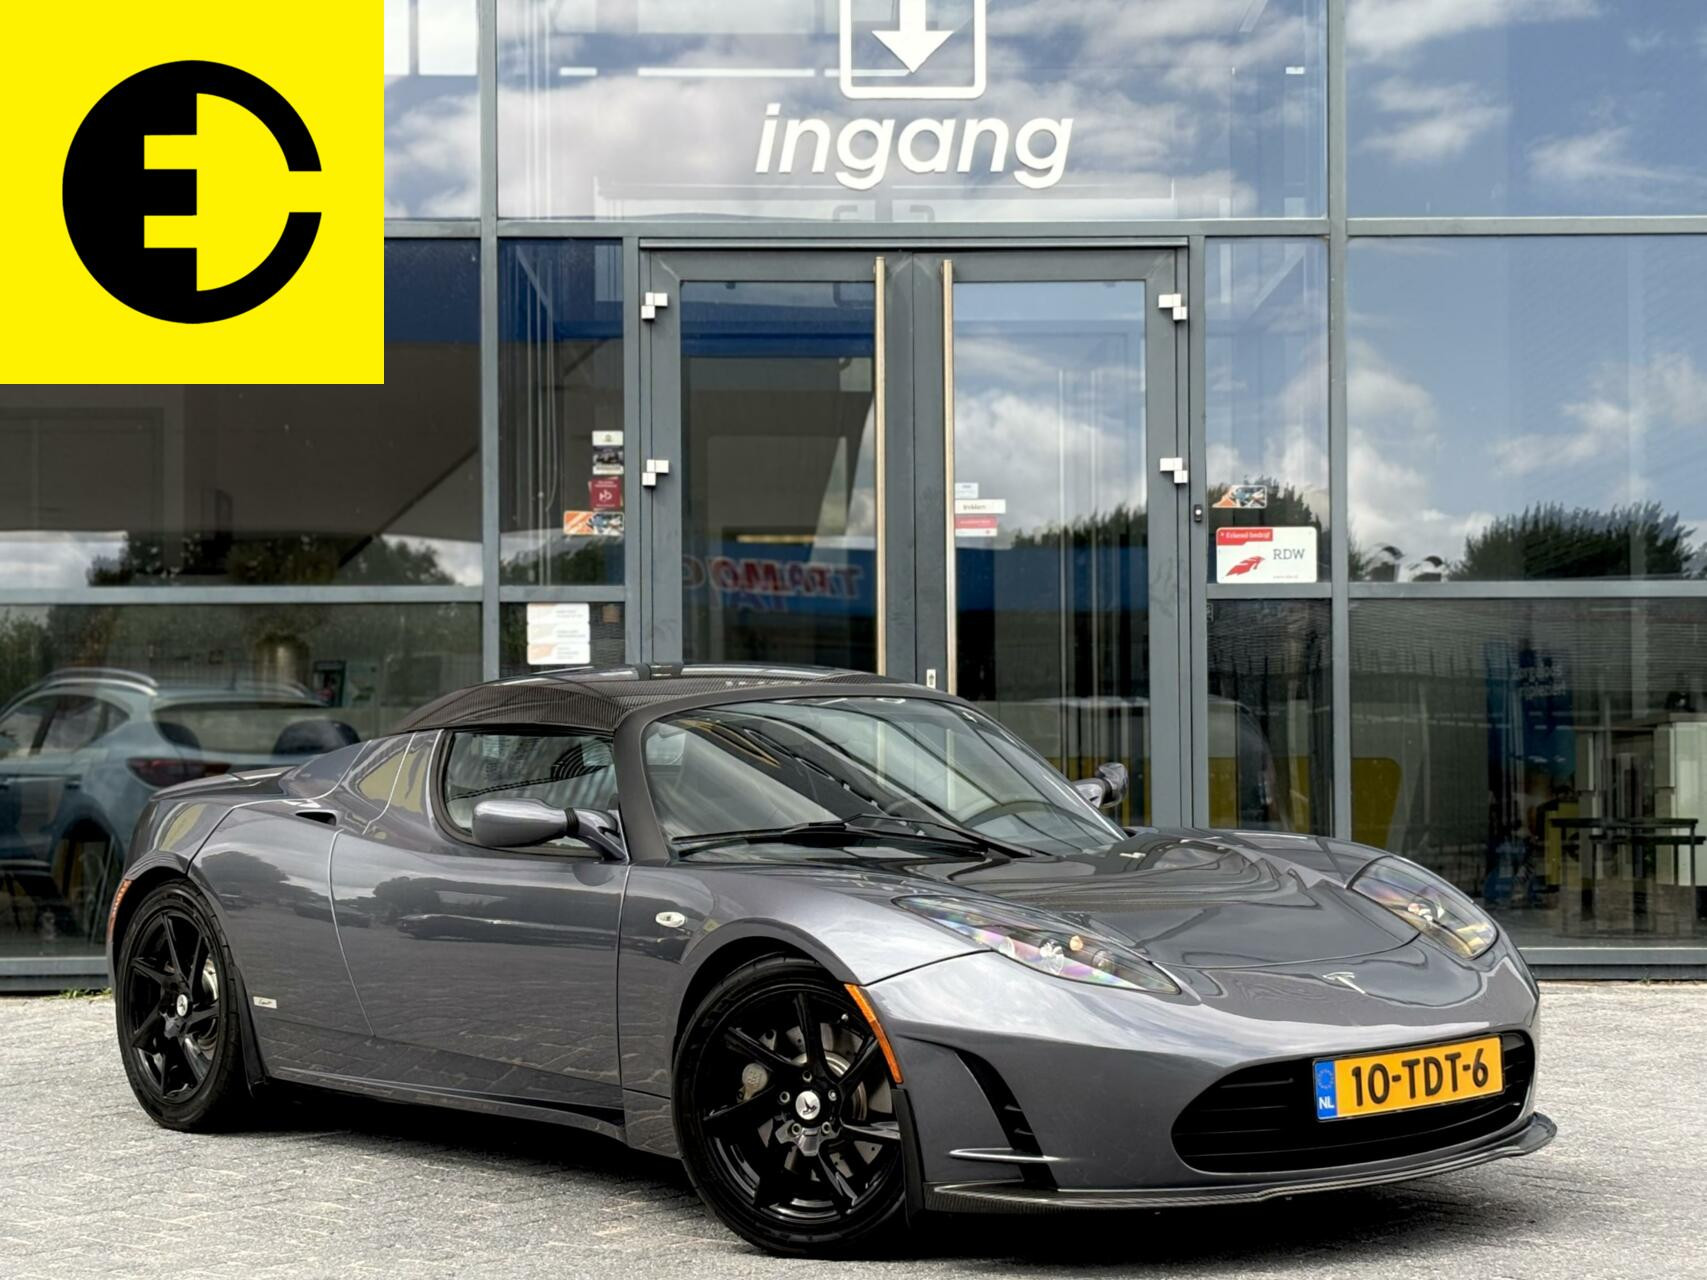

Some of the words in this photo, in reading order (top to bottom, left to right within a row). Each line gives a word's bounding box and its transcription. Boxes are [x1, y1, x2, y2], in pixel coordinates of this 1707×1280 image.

[755, 102, 1074, 190] ingang
[1272, 548, 1306, 560] RDW
[1351, 1048, 1489, 1107] 10-TDT-6
[1318, 1096, 1335, 1110] NL
